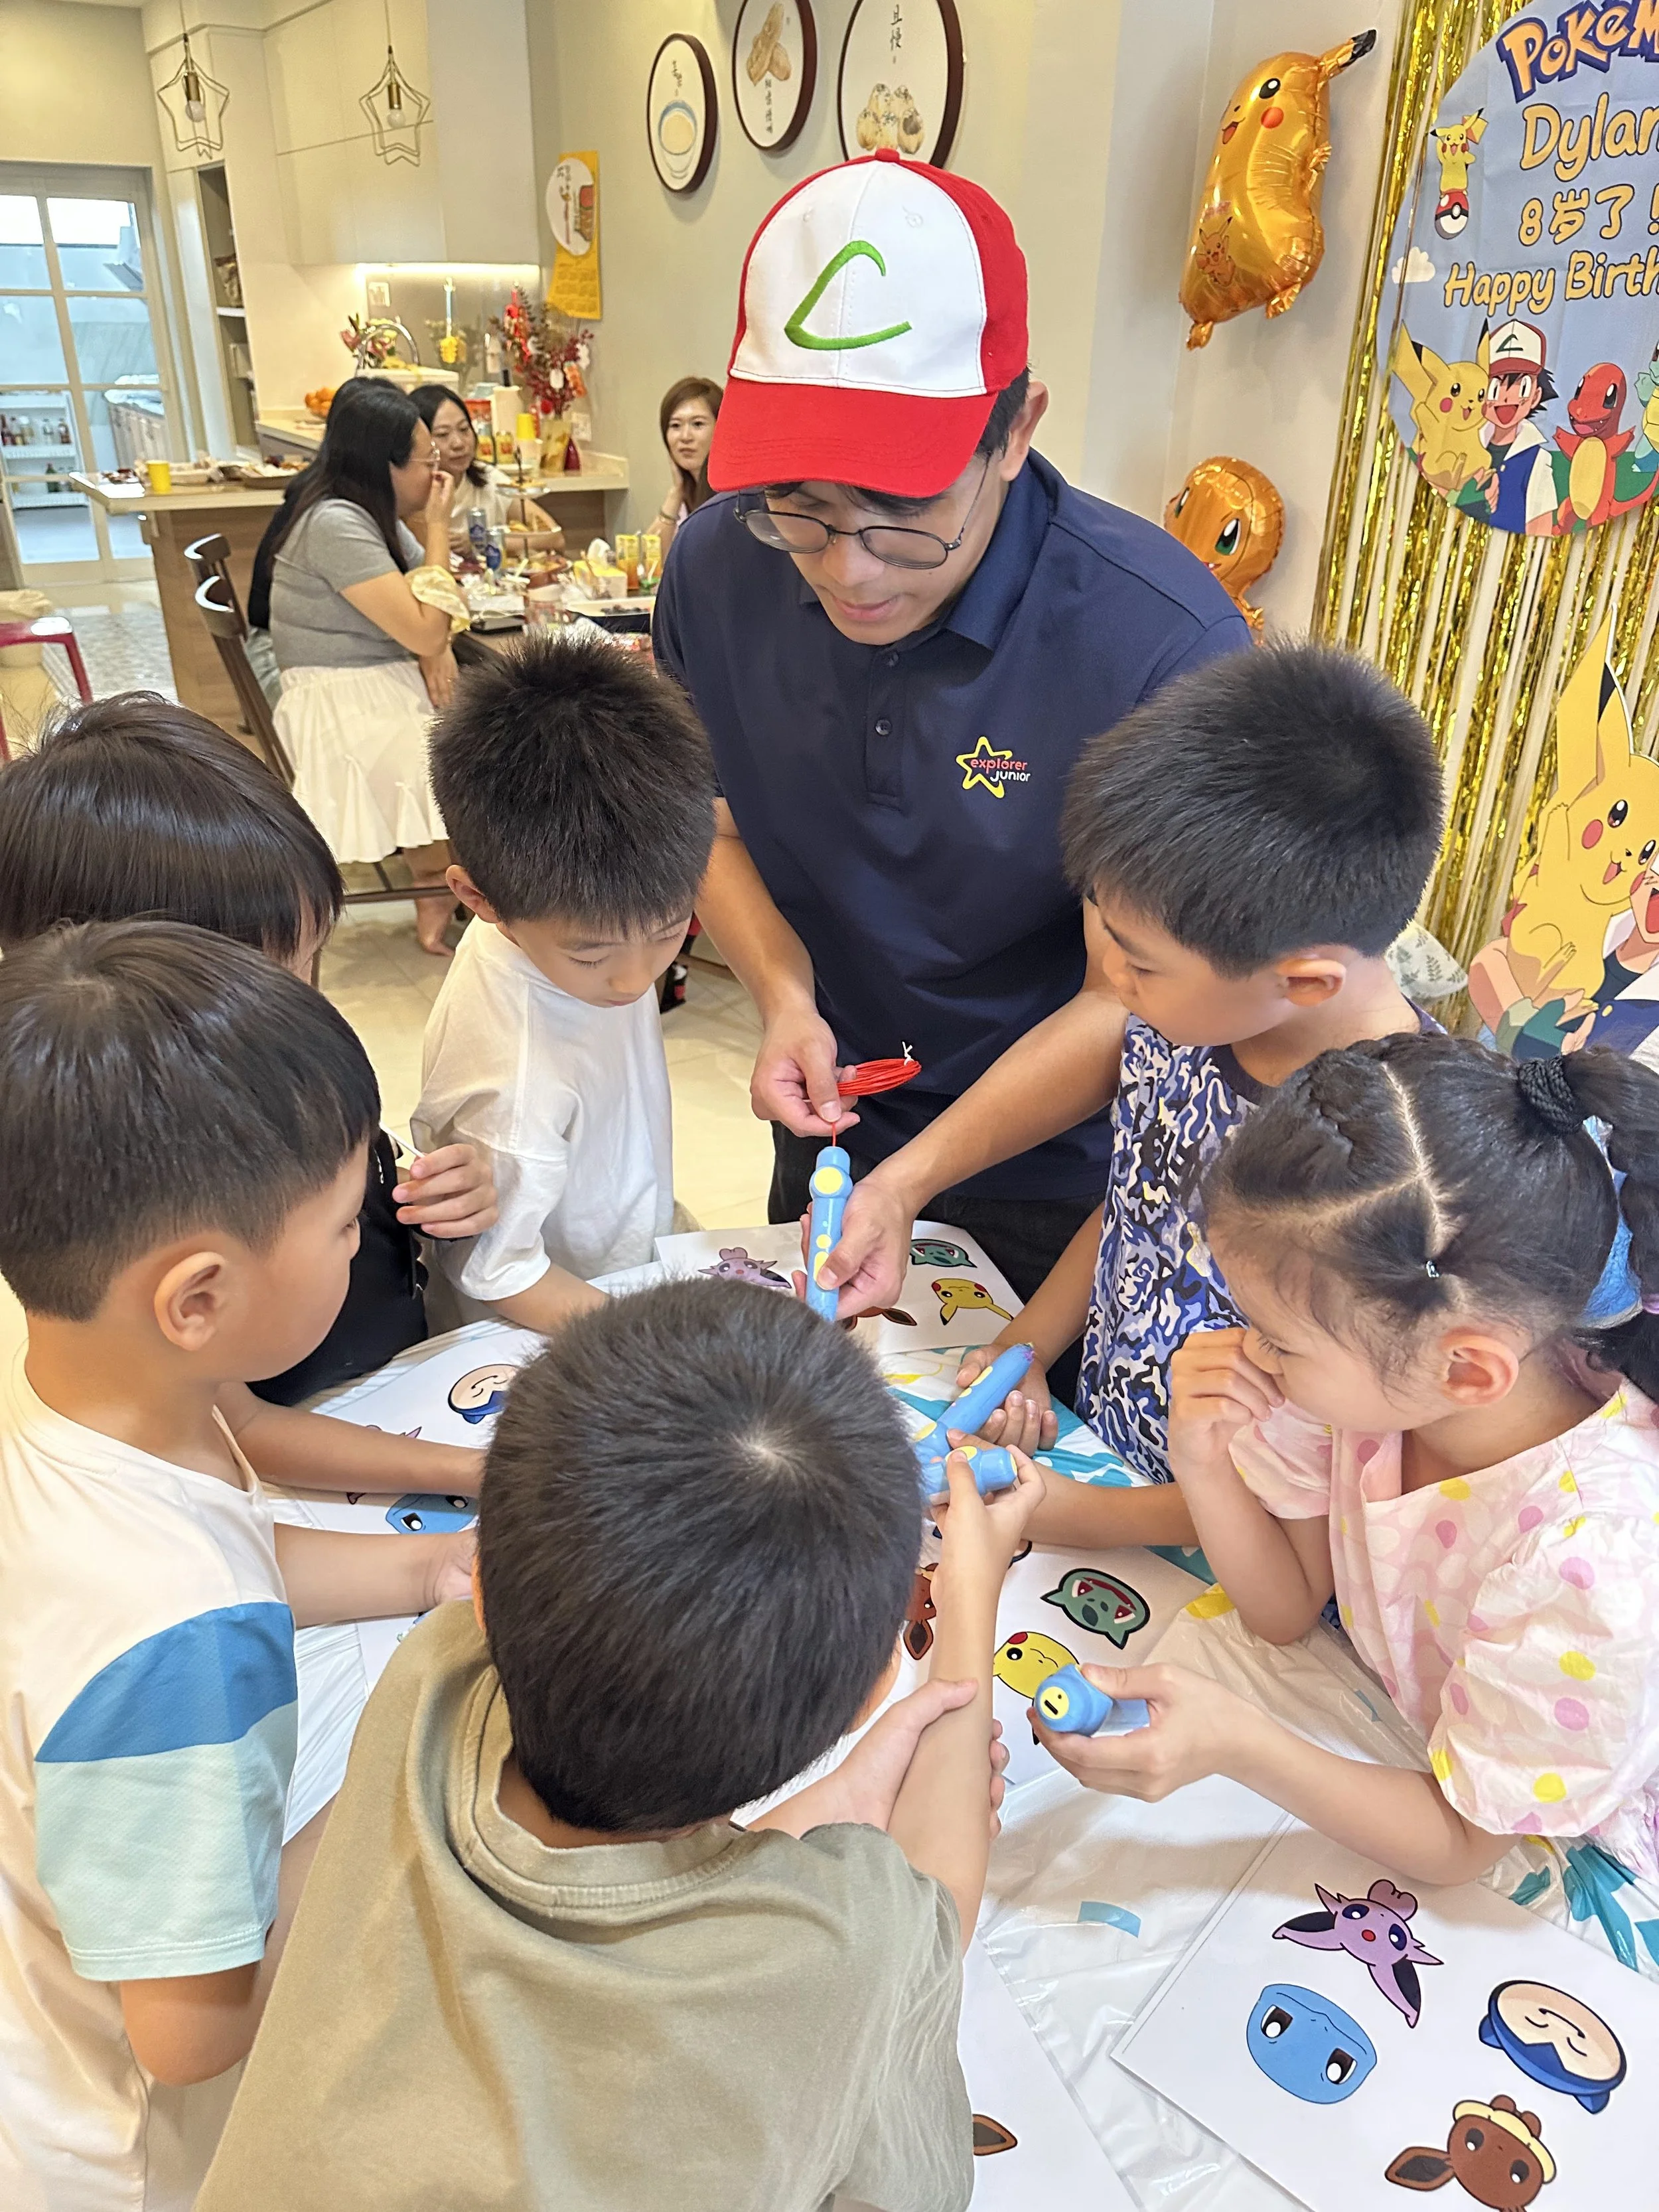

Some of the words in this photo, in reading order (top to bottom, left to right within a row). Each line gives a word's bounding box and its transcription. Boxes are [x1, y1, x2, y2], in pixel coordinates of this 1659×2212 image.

[1444, 261, 1555, 317] Happy
[970, 758, 1027, 774] explorer
[989, 771, 1031, 782] junior
